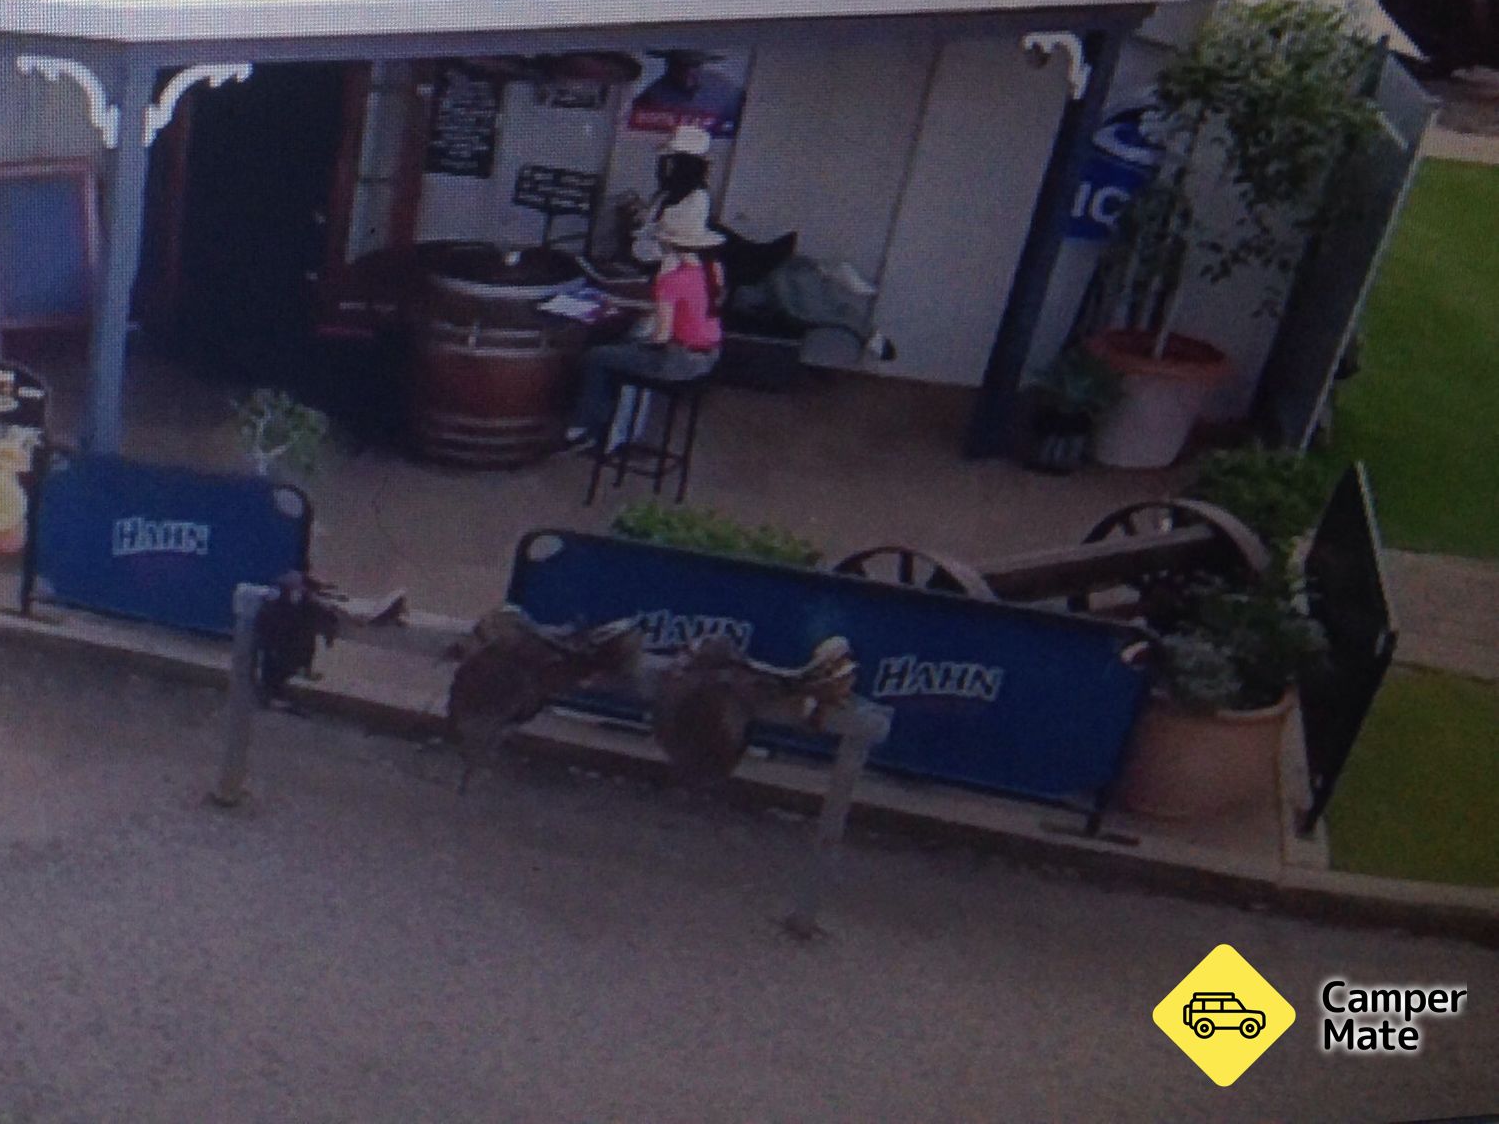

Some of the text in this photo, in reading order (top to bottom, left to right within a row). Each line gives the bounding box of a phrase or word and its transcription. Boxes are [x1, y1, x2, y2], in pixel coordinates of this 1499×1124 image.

[1070, 180, 1132, 226] IC
[112, 516, 210, 556] HAHN
[872, 655, 1004, 702] HAHN
